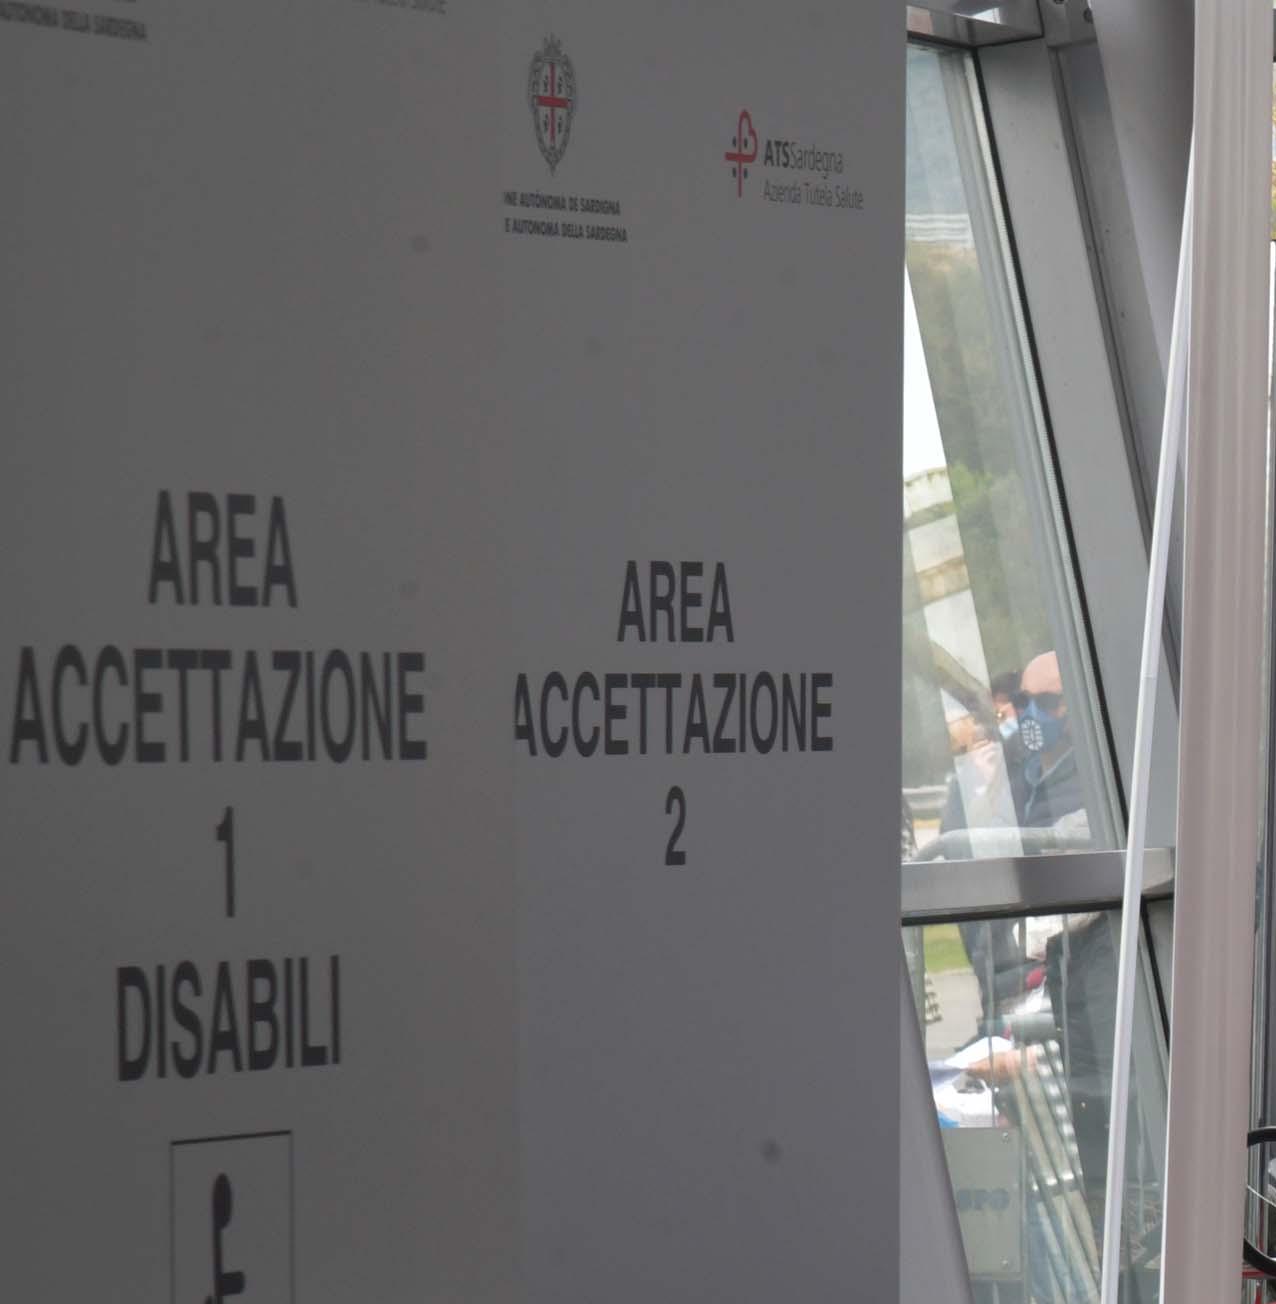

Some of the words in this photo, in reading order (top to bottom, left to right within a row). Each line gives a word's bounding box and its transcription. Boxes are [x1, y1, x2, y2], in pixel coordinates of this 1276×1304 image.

[836, 184, 865, 209] Salute
[149, 489, 299, 610] AREA
[617, 560, 736, 643] AREA
[10, 644, 428, 767] ACCETTAZIONE
[514, 671, 834, 758] ACCETTAZIONE
[215, 805, 237, 919] 1
[665, 786, 687, 867] 2
[117, 955, 341, 1083] DISABILI
